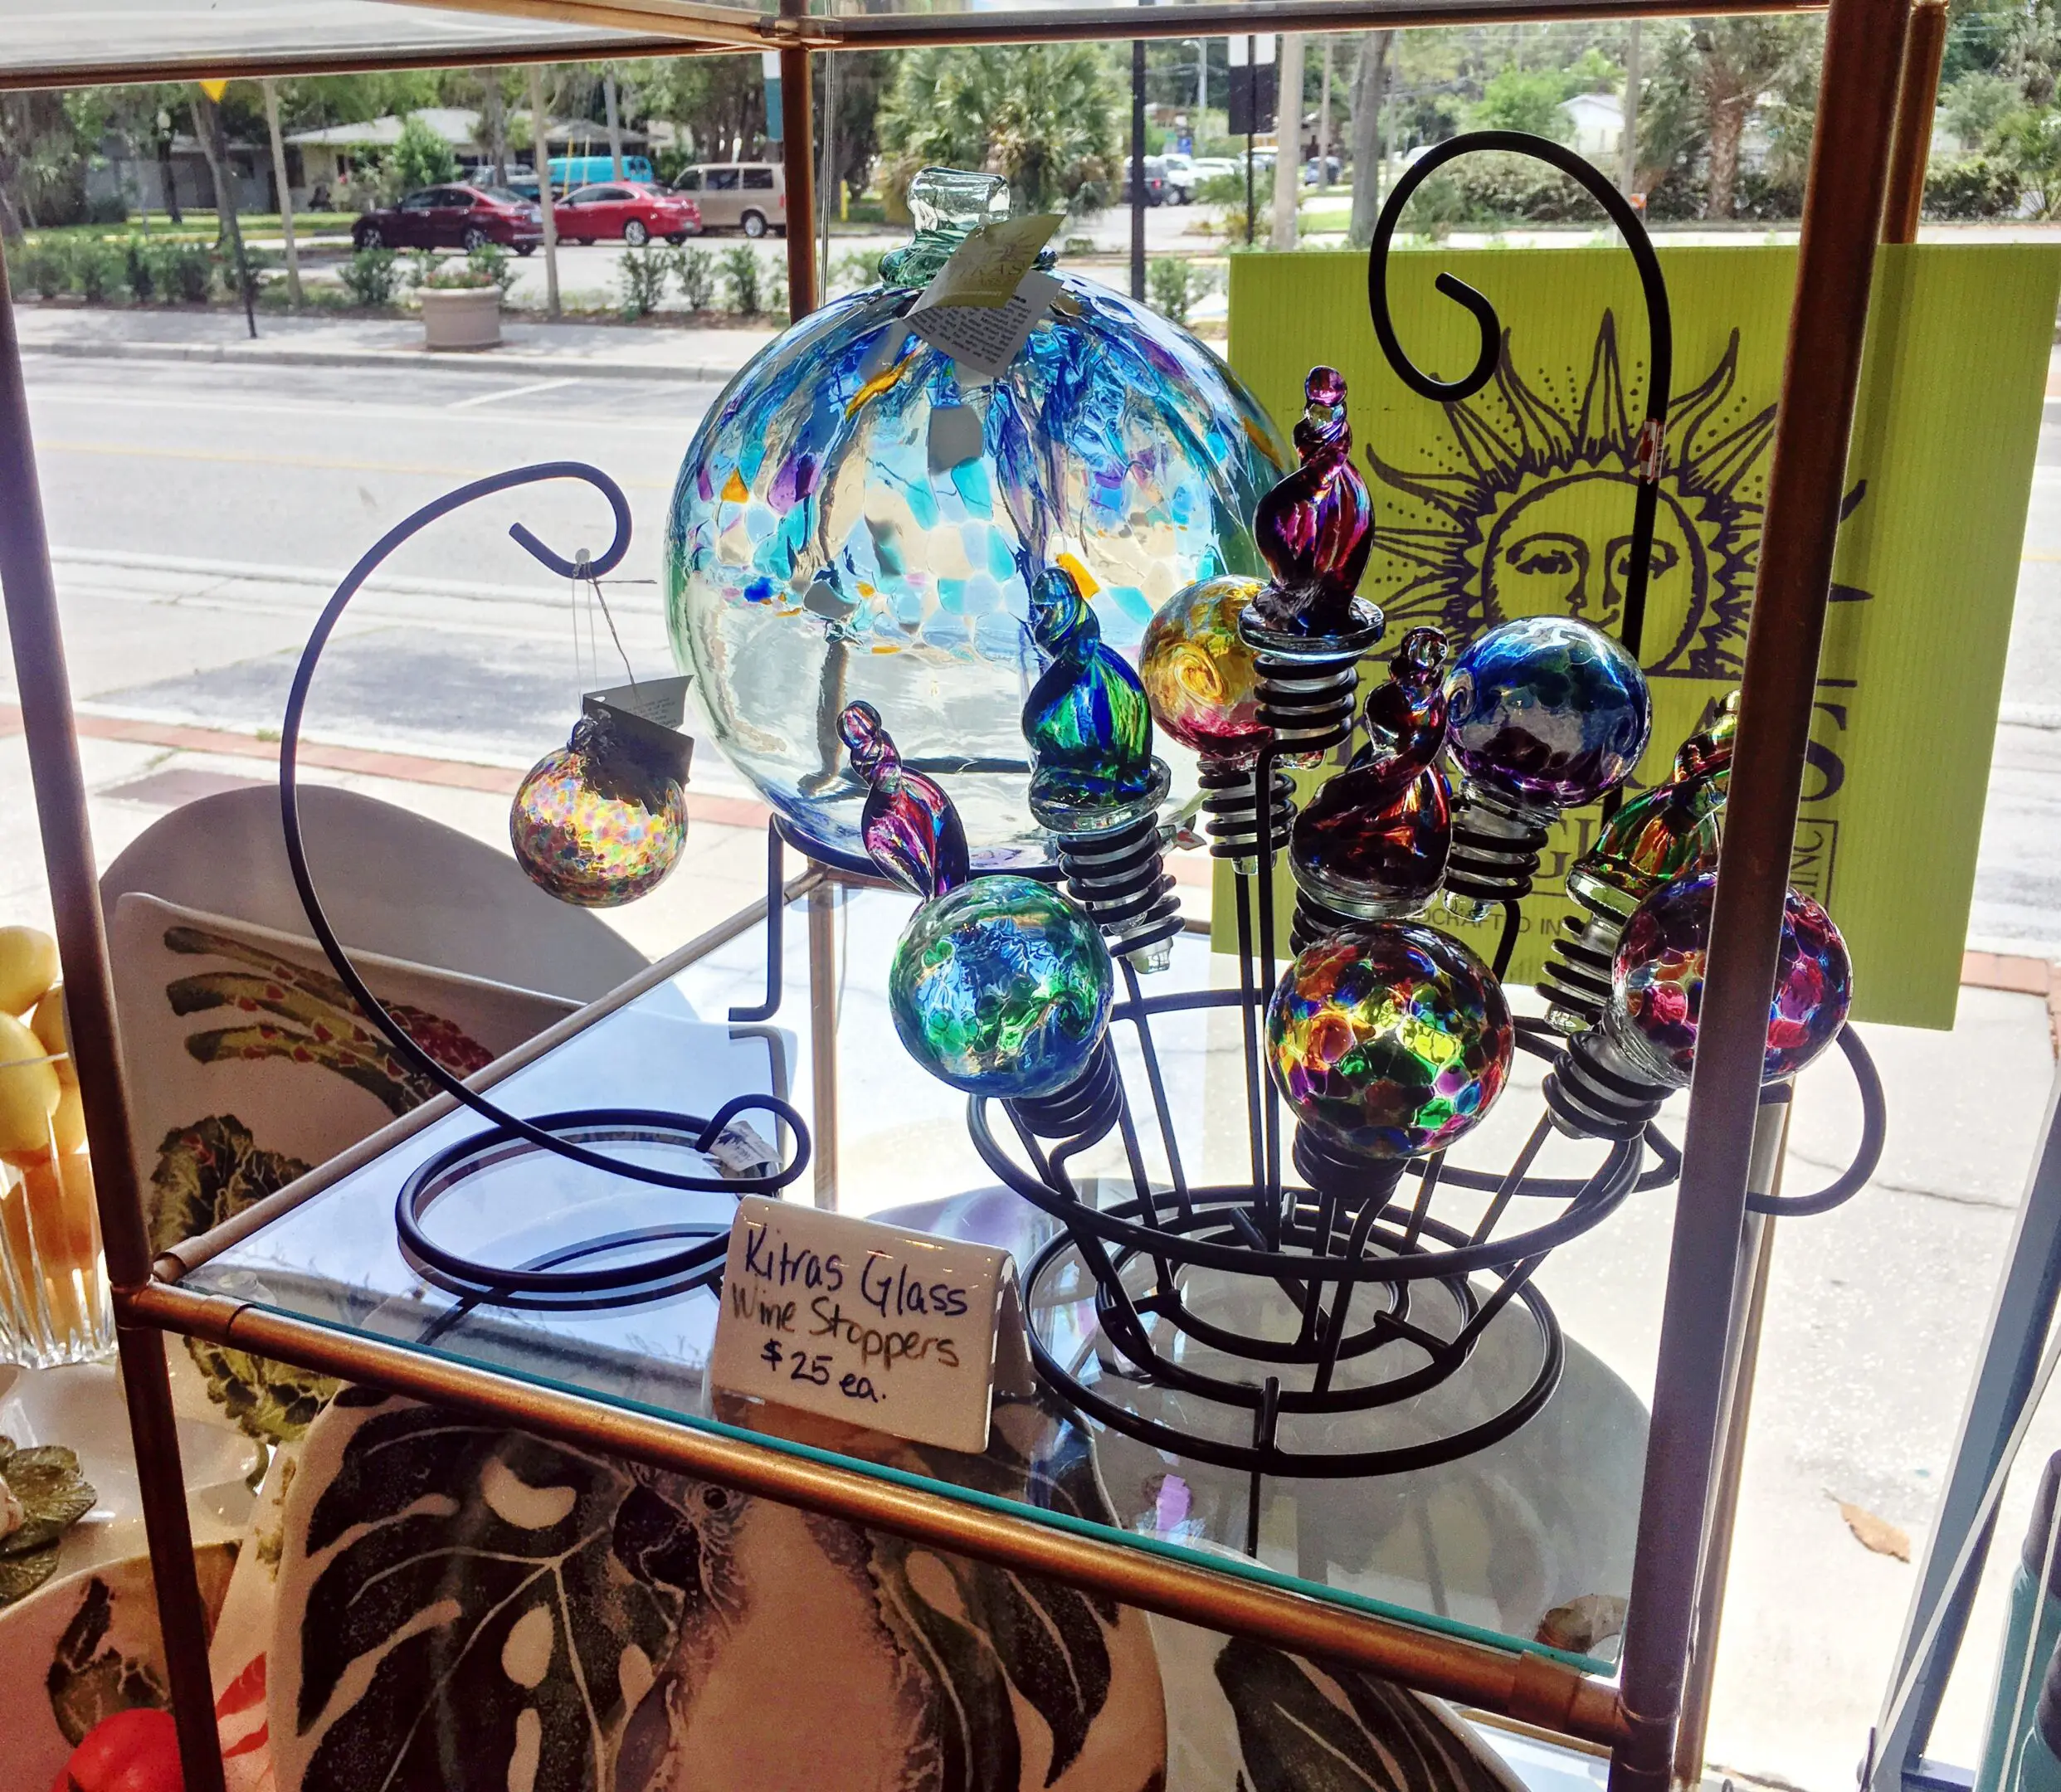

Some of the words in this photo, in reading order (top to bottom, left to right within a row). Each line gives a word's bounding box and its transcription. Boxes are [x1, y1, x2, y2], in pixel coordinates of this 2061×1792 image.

[745, 1223, 843, 1291] Kitras
[860, 1249, 968, 1317] Glass
[732, 1279, 797, 1332] Wine
[809, 1296, 959, 1371] Stoppers
[838, 1372, 886, 1403] ea.
